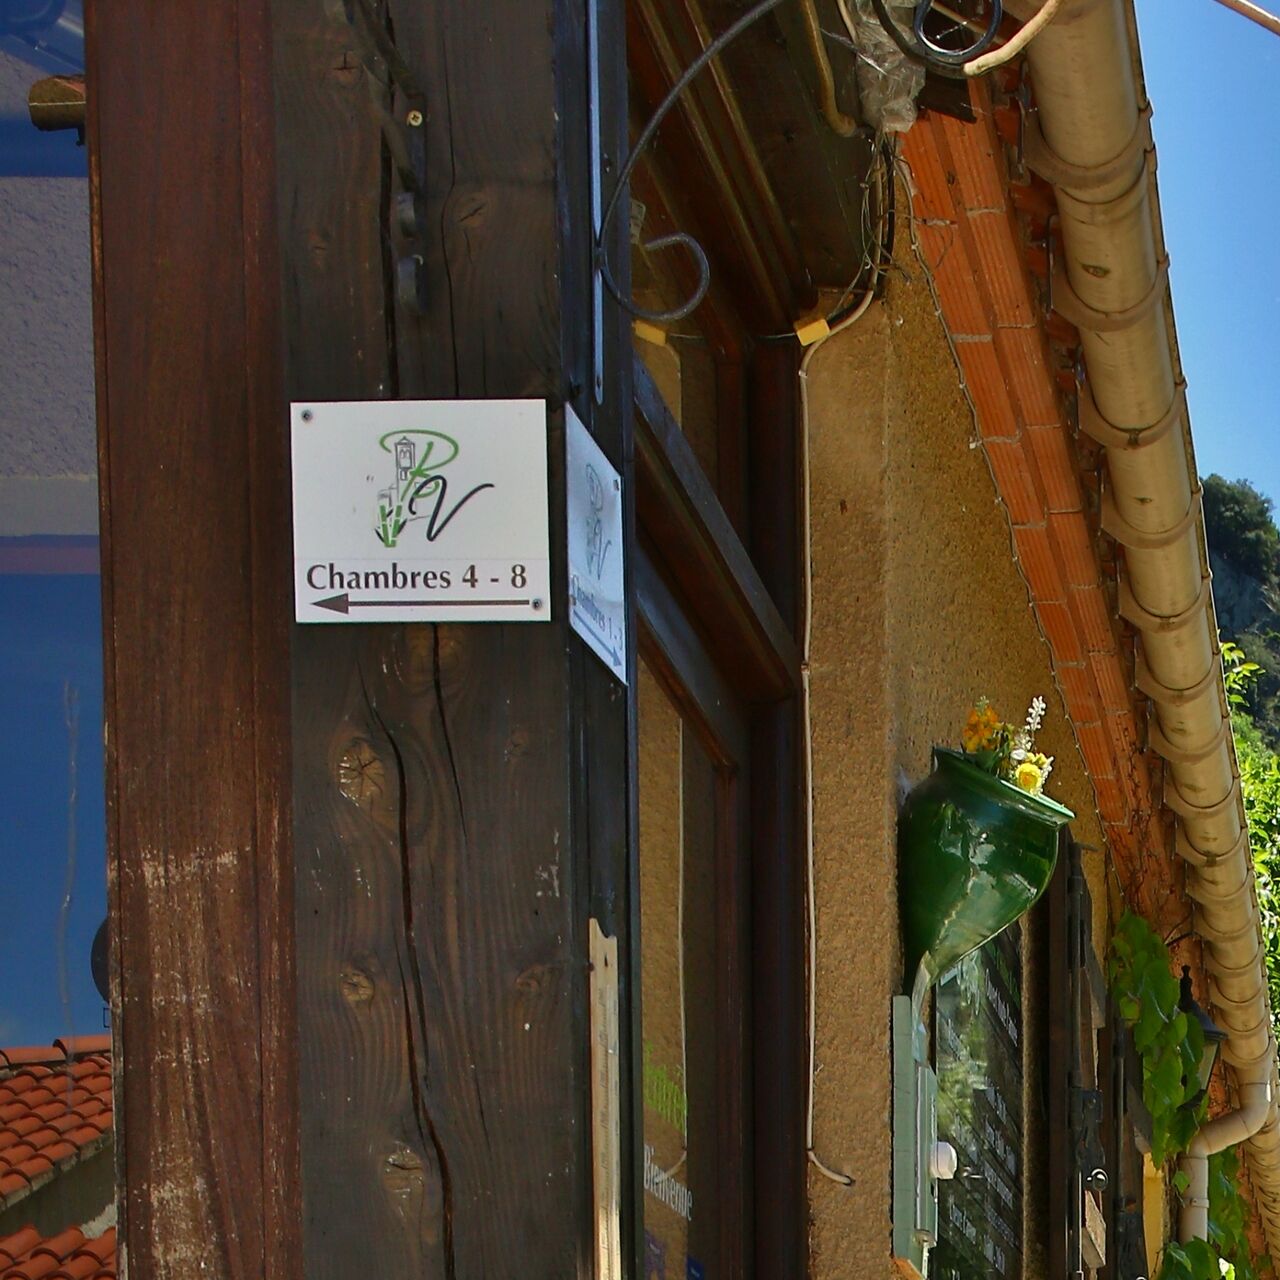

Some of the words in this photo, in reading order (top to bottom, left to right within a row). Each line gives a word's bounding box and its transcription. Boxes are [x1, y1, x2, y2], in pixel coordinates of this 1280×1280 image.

[306, 562, 451, 590] Chambres
[461, 564, 478, 589] 4
[510, 563, 528, 589] 8
[643, 1143, 693, 1222] Bienvenue
